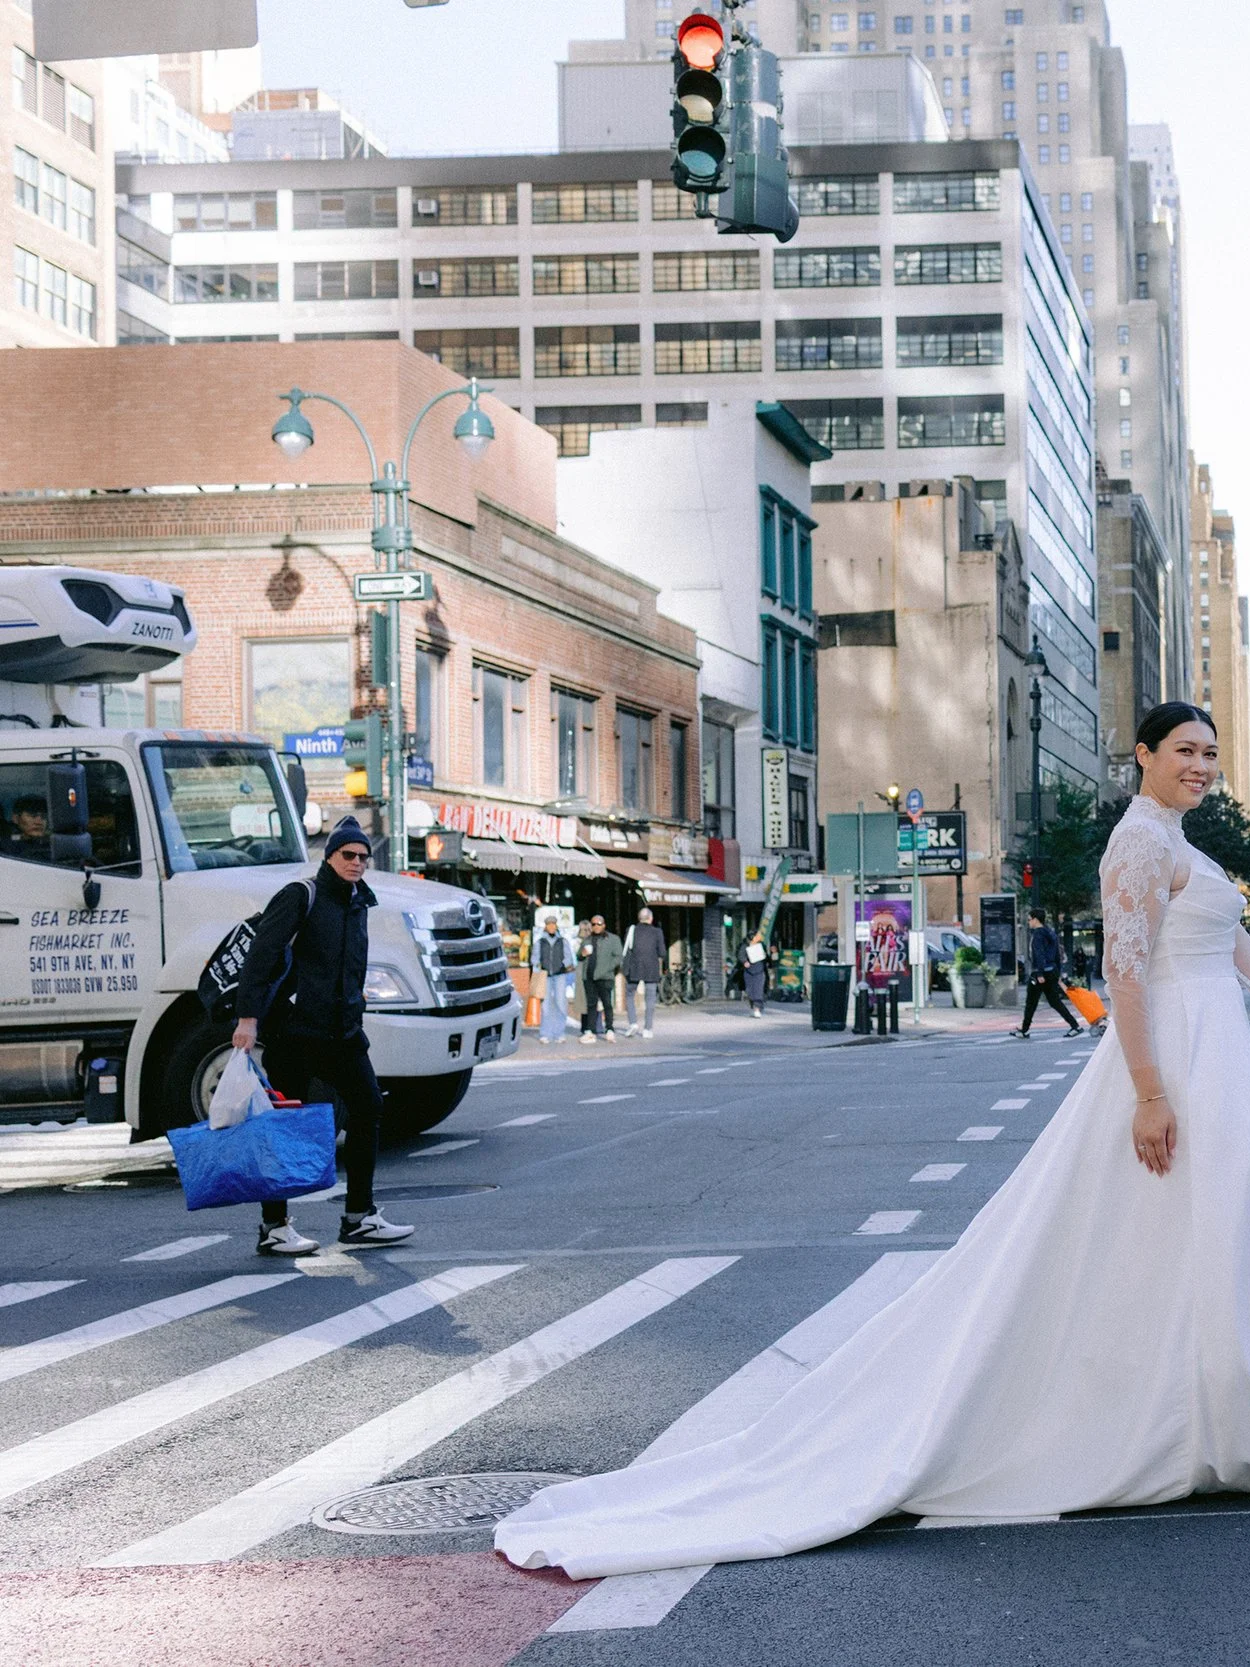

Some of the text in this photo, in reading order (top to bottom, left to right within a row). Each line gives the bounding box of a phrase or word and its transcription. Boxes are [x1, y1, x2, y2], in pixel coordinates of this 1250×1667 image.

[131, 622, 174, 640] ZANOTTI
[295, 738, 337, 753] Ninth
[926, 828, 958, 847] RK
[31, 909, 129, 927] SEA BREEZE
[29, 932, 135, 951] FISHMARKET INC.
[30, 957, 46, 972] 541
[51, 956, 70, 971] 9TH
[122, 954, 135, 970] NY
[865, 951, 907, 972] FAIR
[85, 977, 103, 992] GVW
